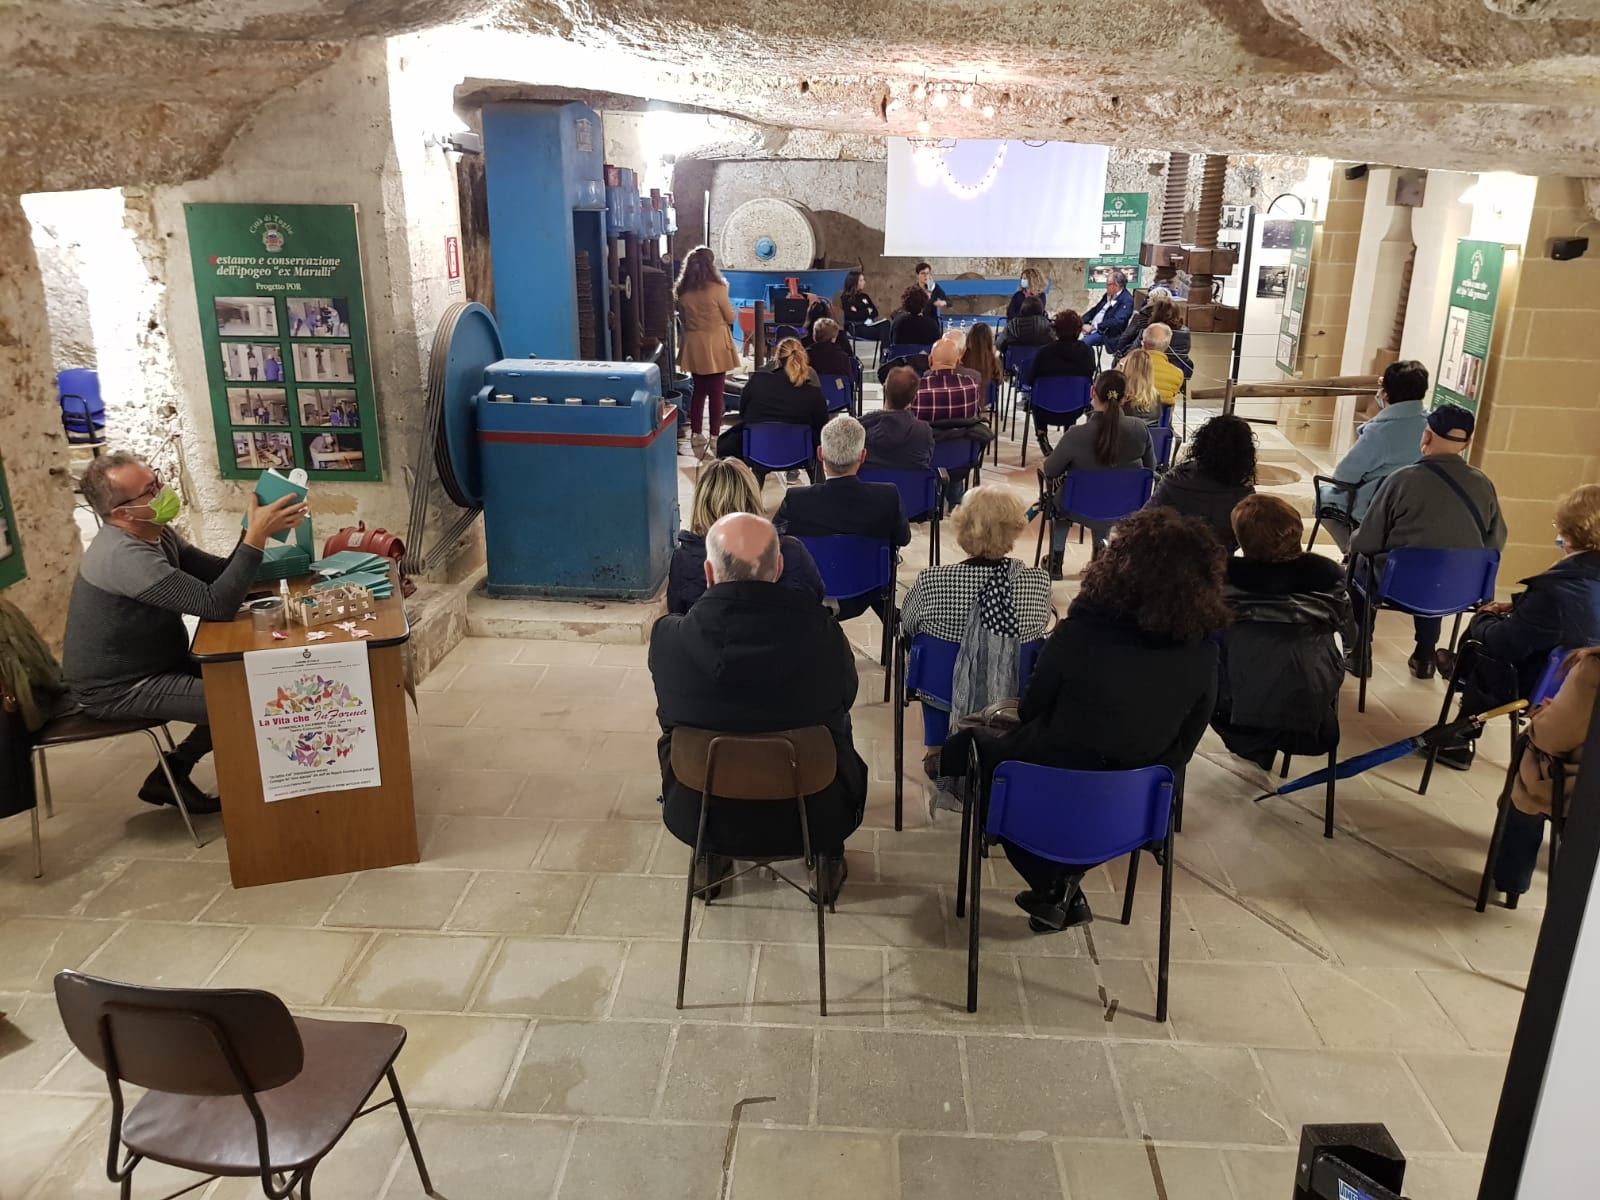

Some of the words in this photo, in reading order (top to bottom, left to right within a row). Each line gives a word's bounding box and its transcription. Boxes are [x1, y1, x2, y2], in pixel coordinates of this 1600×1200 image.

[258, 257, 265, 265] e
[266, 256, 341, 266] conservazione
[216, 265, 272, 278] dell'ipogeo
[255, 282, 286, 291] Progetto
[258, 719, 270, 727] La
[272, 717, 290, 726] Vita
[293, 715, 310, 723] che
